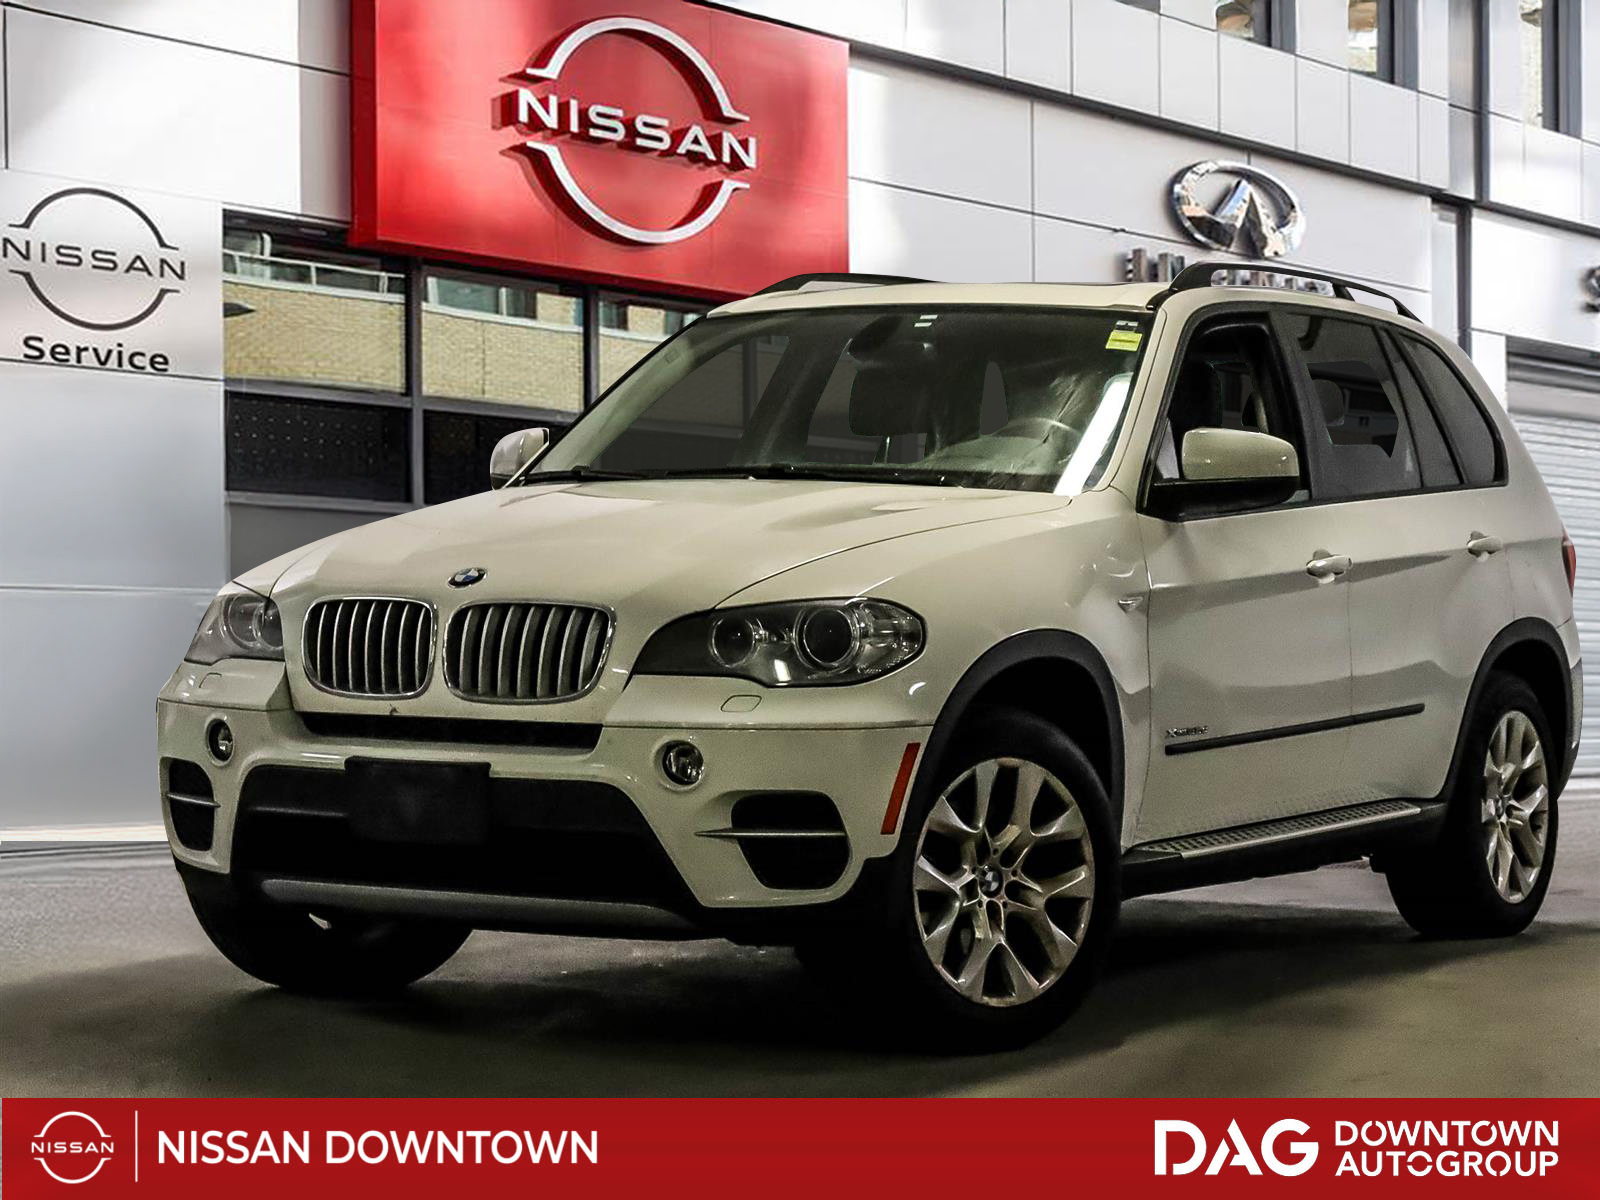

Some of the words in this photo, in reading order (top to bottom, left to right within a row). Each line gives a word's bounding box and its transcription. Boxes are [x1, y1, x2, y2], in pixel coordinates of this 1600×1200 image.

[517, 88, 757, 169] NISSAN
[2, 237, 186, 281] NISSAN
[22, 335, 170, 373] Service
